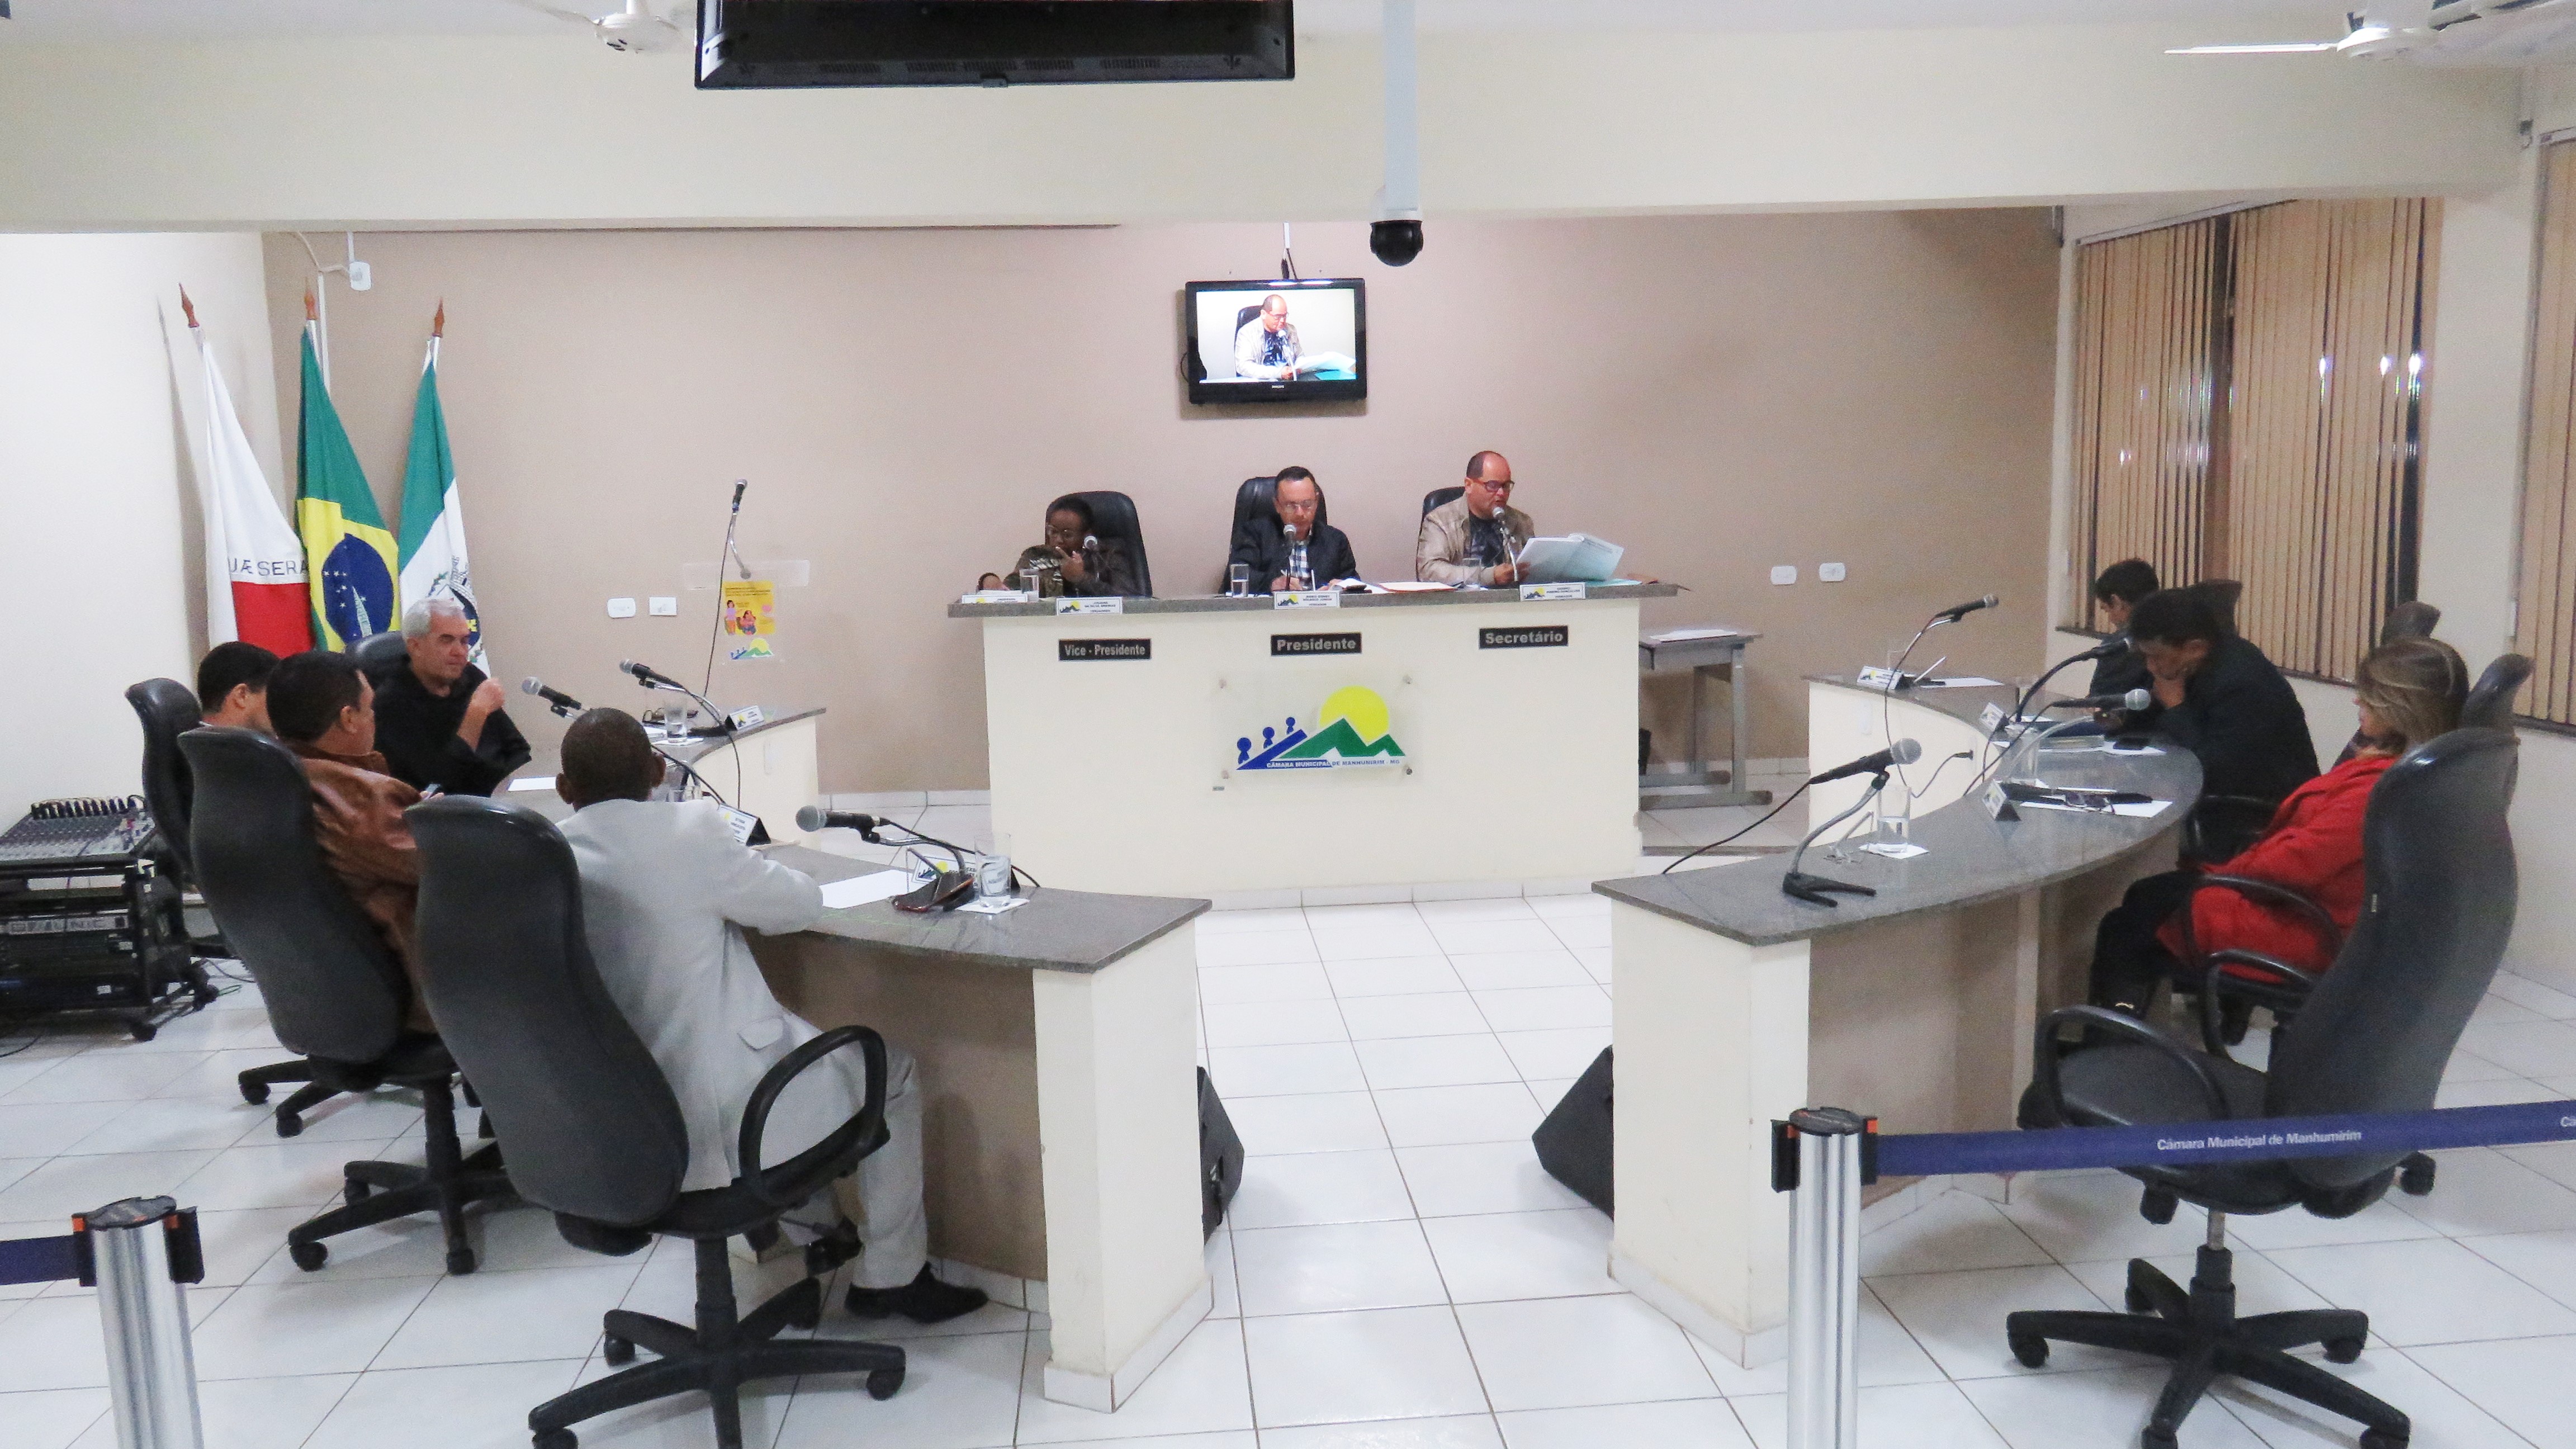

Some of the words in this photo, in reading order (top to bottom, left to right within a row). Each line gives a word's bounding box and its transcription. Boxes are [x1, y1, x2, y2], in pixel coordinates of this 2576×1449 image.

[1485, 631, 1564, 644] Secretário
[1064, 645, 1086, 656] Vice
[1094, 644, 1145, 656] Presidente
[1277, 638, 1356, 651] Presidente
[2157, 1138, 2205, 1150] Câmara
[2208, 1134, 2266, 1148] Municipal
[2269, 1134, 2284, 1145] de
[2286, 1130, 2361, 1144] Manhumirim
